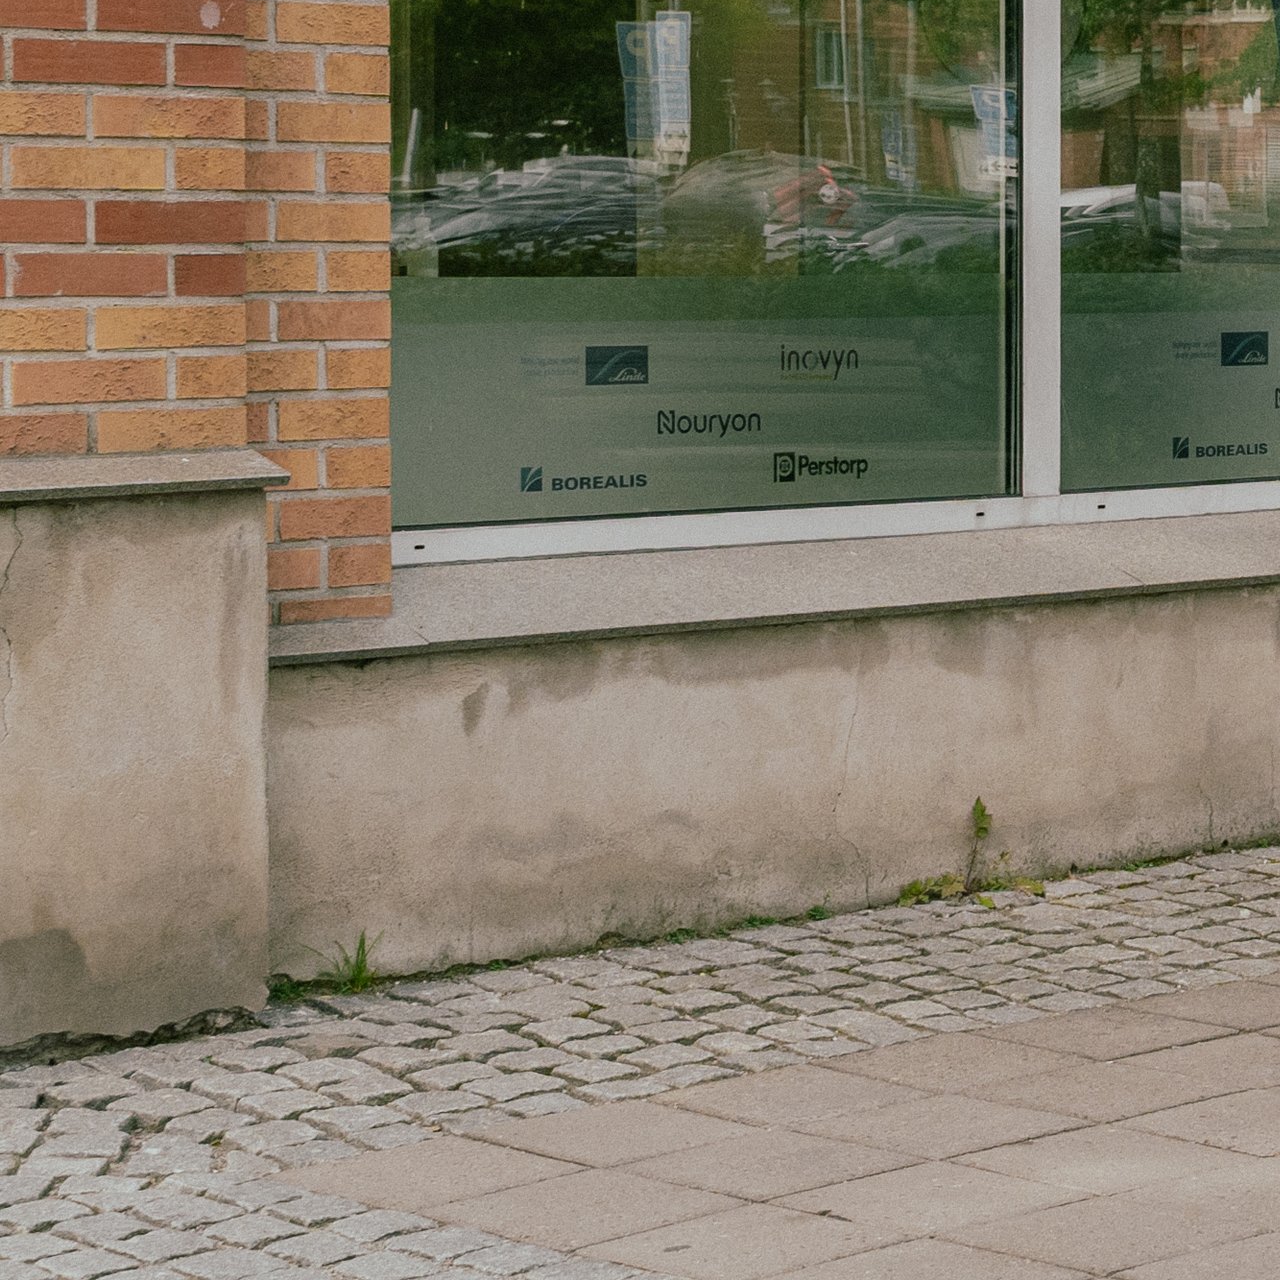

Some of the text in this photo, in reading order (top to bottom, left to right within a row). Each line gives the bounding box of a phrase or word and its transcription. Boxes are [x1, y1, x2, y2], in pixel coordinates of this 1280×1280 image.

[780, 344, 858, 380] inovyn
[608, 367, 646, 382] Linde
[657, 410, 761, 438] Nouryon
[1196, 443, 1268, 458] BOREALIS
[798, 455, 868, 479] Perstorp
[551, 474, 648, 491] BOREALIS
